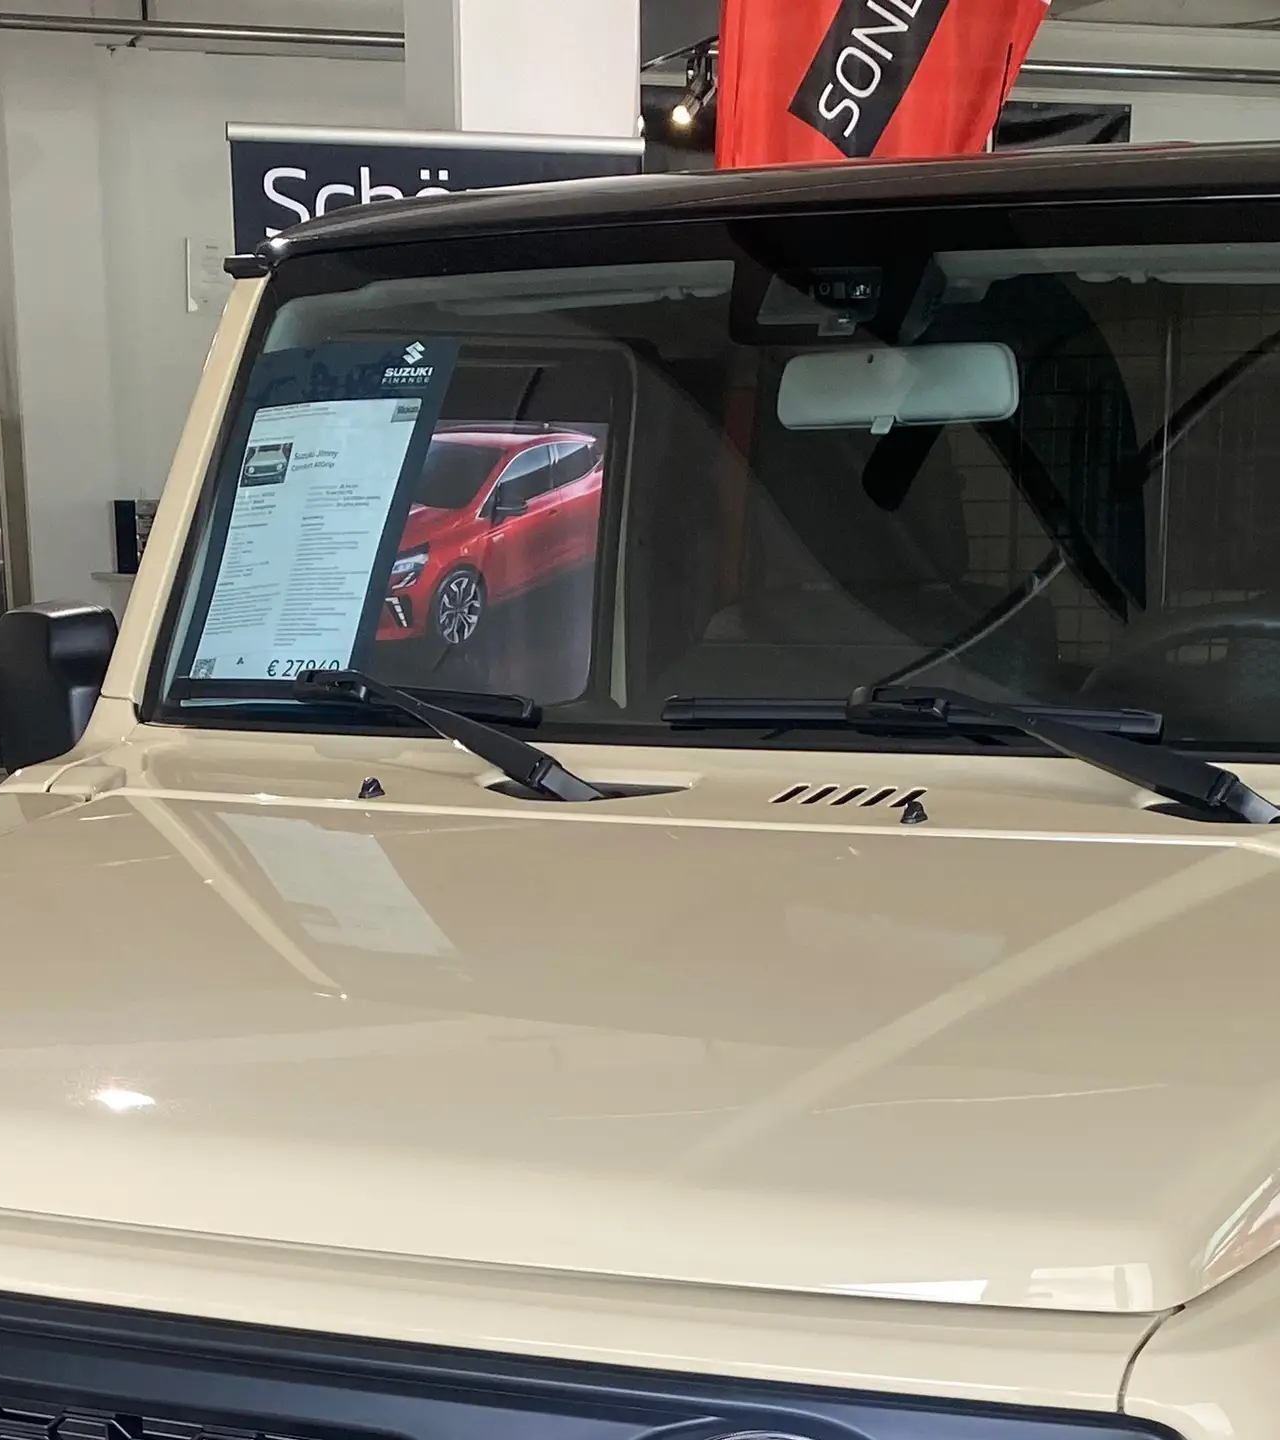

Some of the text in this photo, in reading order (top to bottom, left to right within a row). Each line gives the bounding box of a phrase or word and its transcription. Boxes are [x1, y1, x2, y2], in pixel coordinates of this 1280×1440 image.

[384, 367, 433, 377] SUZUKI
[381, 377, 430, 385] FINANCE
[267, 660, 279, 677] €
